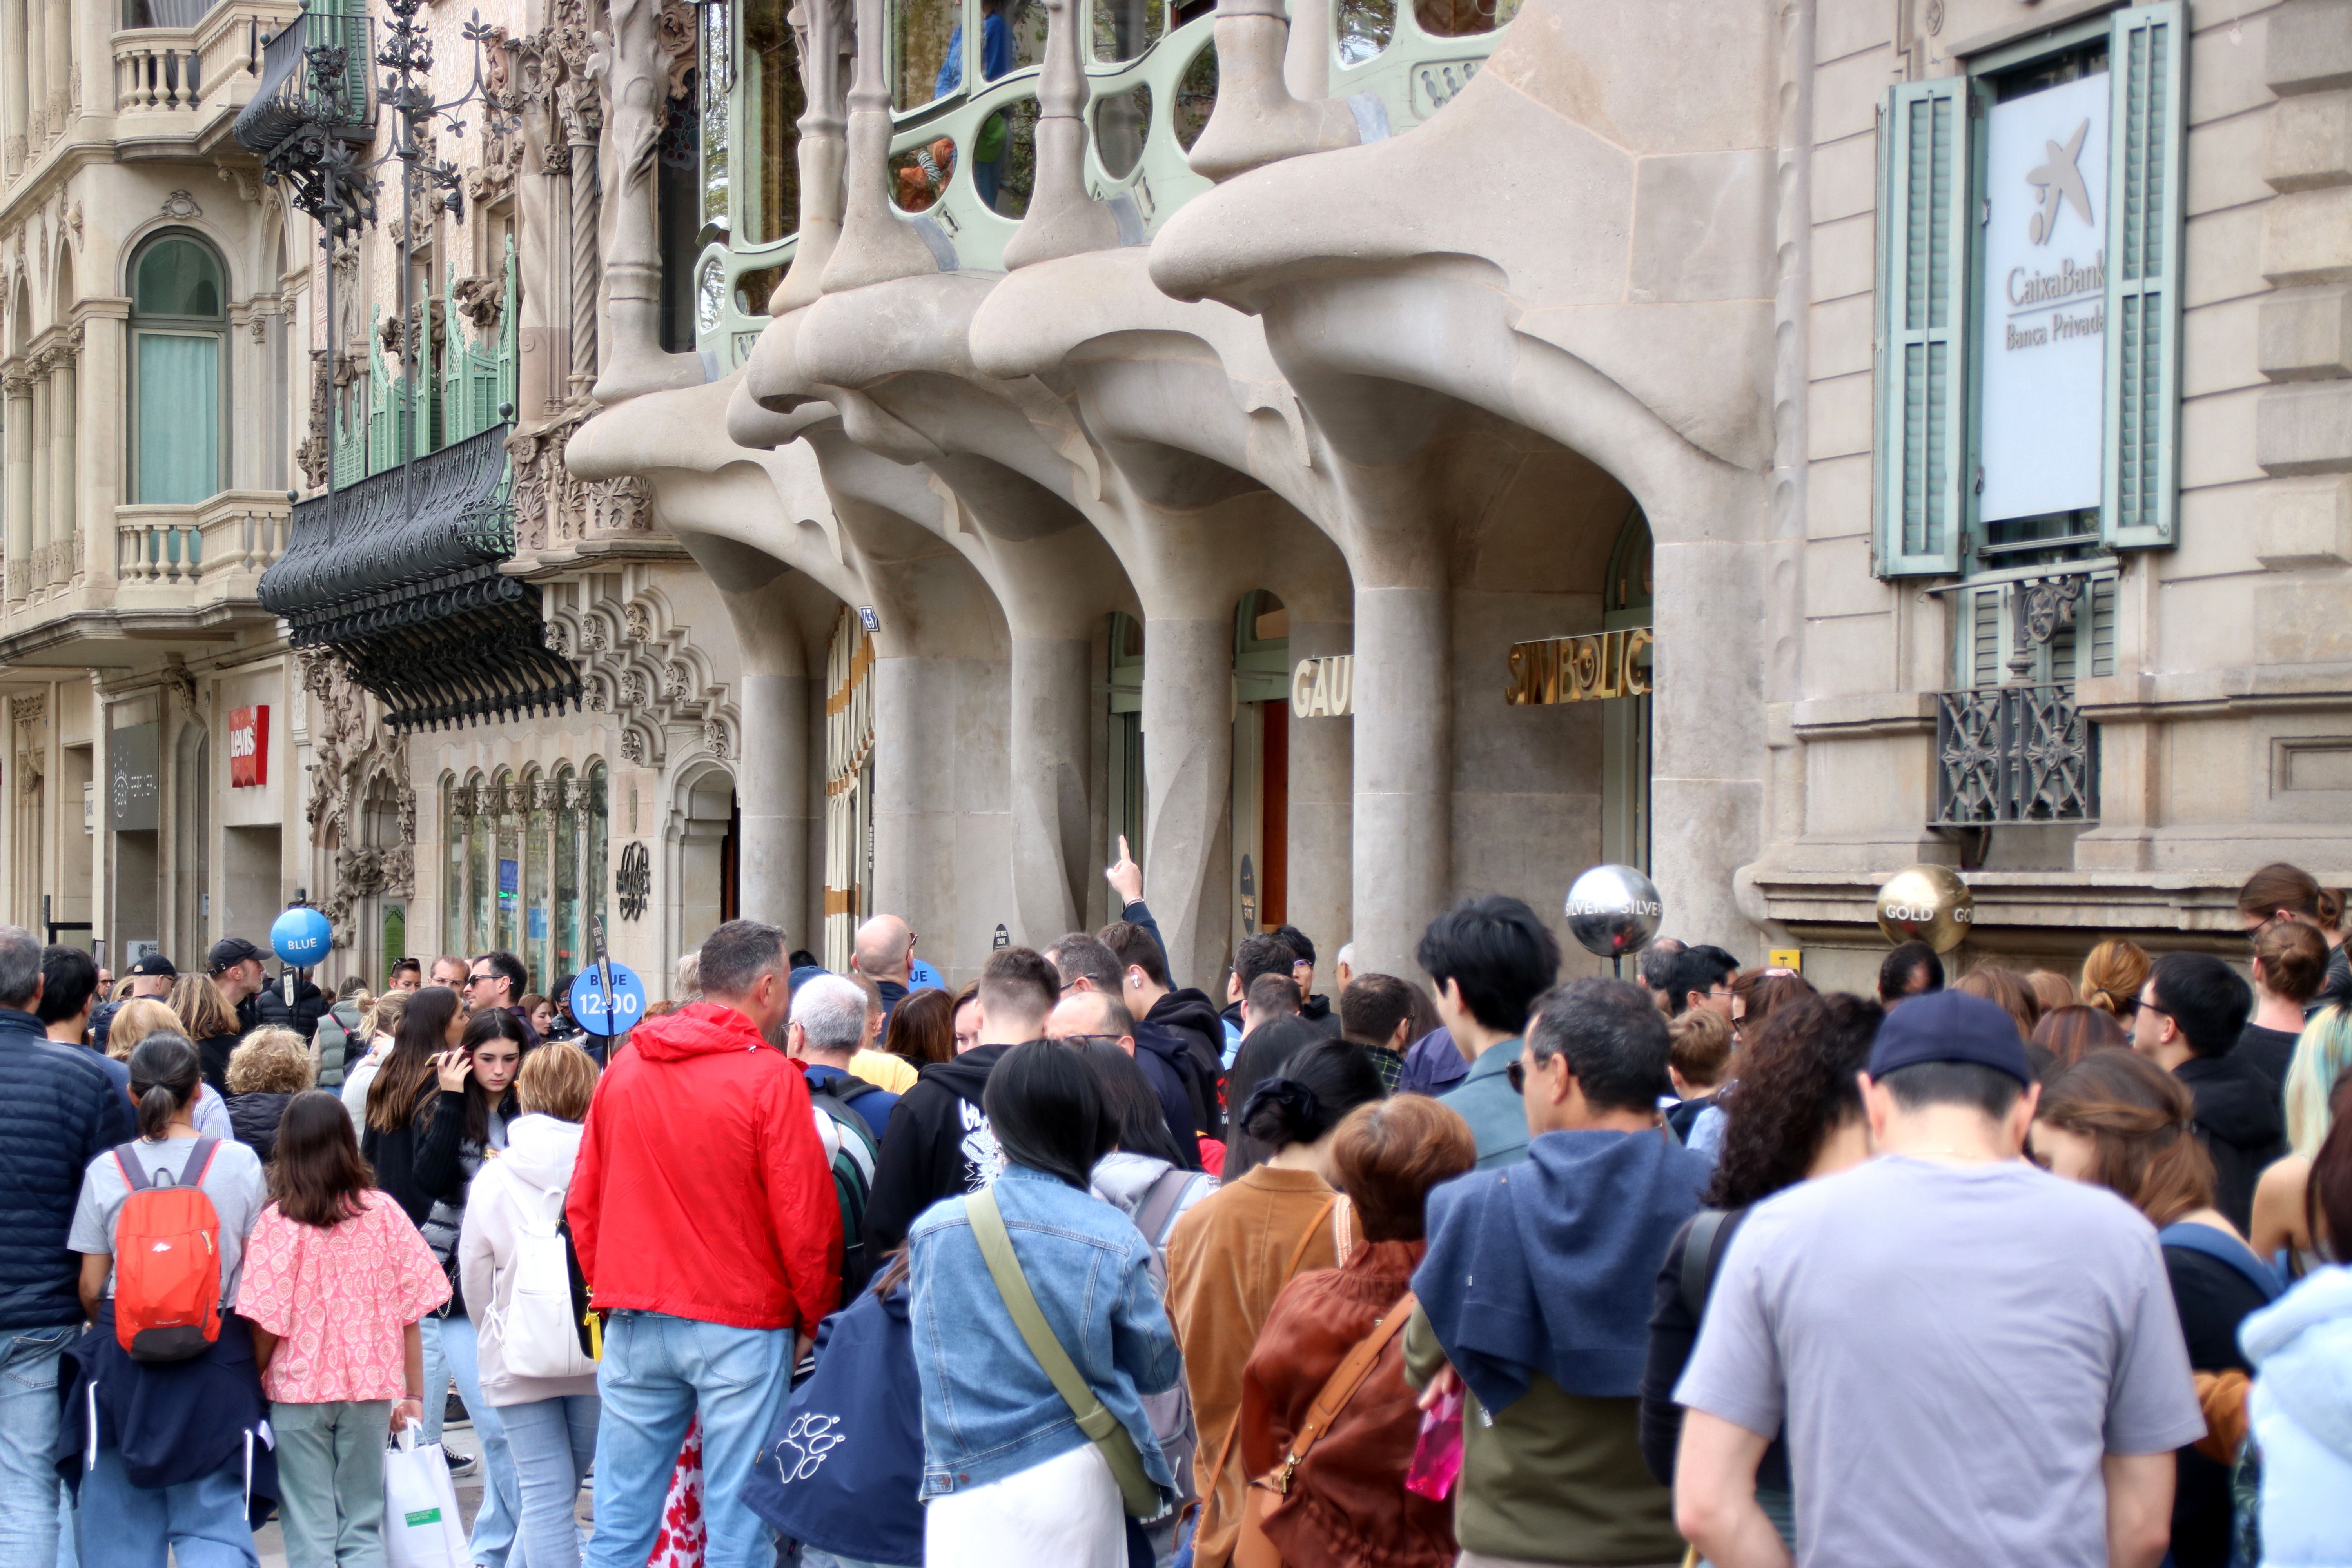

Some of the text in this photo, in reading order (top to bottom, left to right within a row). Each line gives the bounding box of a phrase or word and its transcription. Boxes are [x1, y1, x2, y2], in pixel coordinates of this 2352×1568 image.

[2007, 250, 2105, 306] CaixaBank
[2006, 323, 2047, 350] Banca
[863, 609, 874, 628] 43
[1292, 655, 1355, 718] GAU
[1566, 901, 1606, 917] SILVER
[1886, 905, 1934, 921] GOLD
[288, 938, 317, 950] BLUE
[590, 975, 626, 986] BUE
[580, 993, 637, 1014] 12:00
